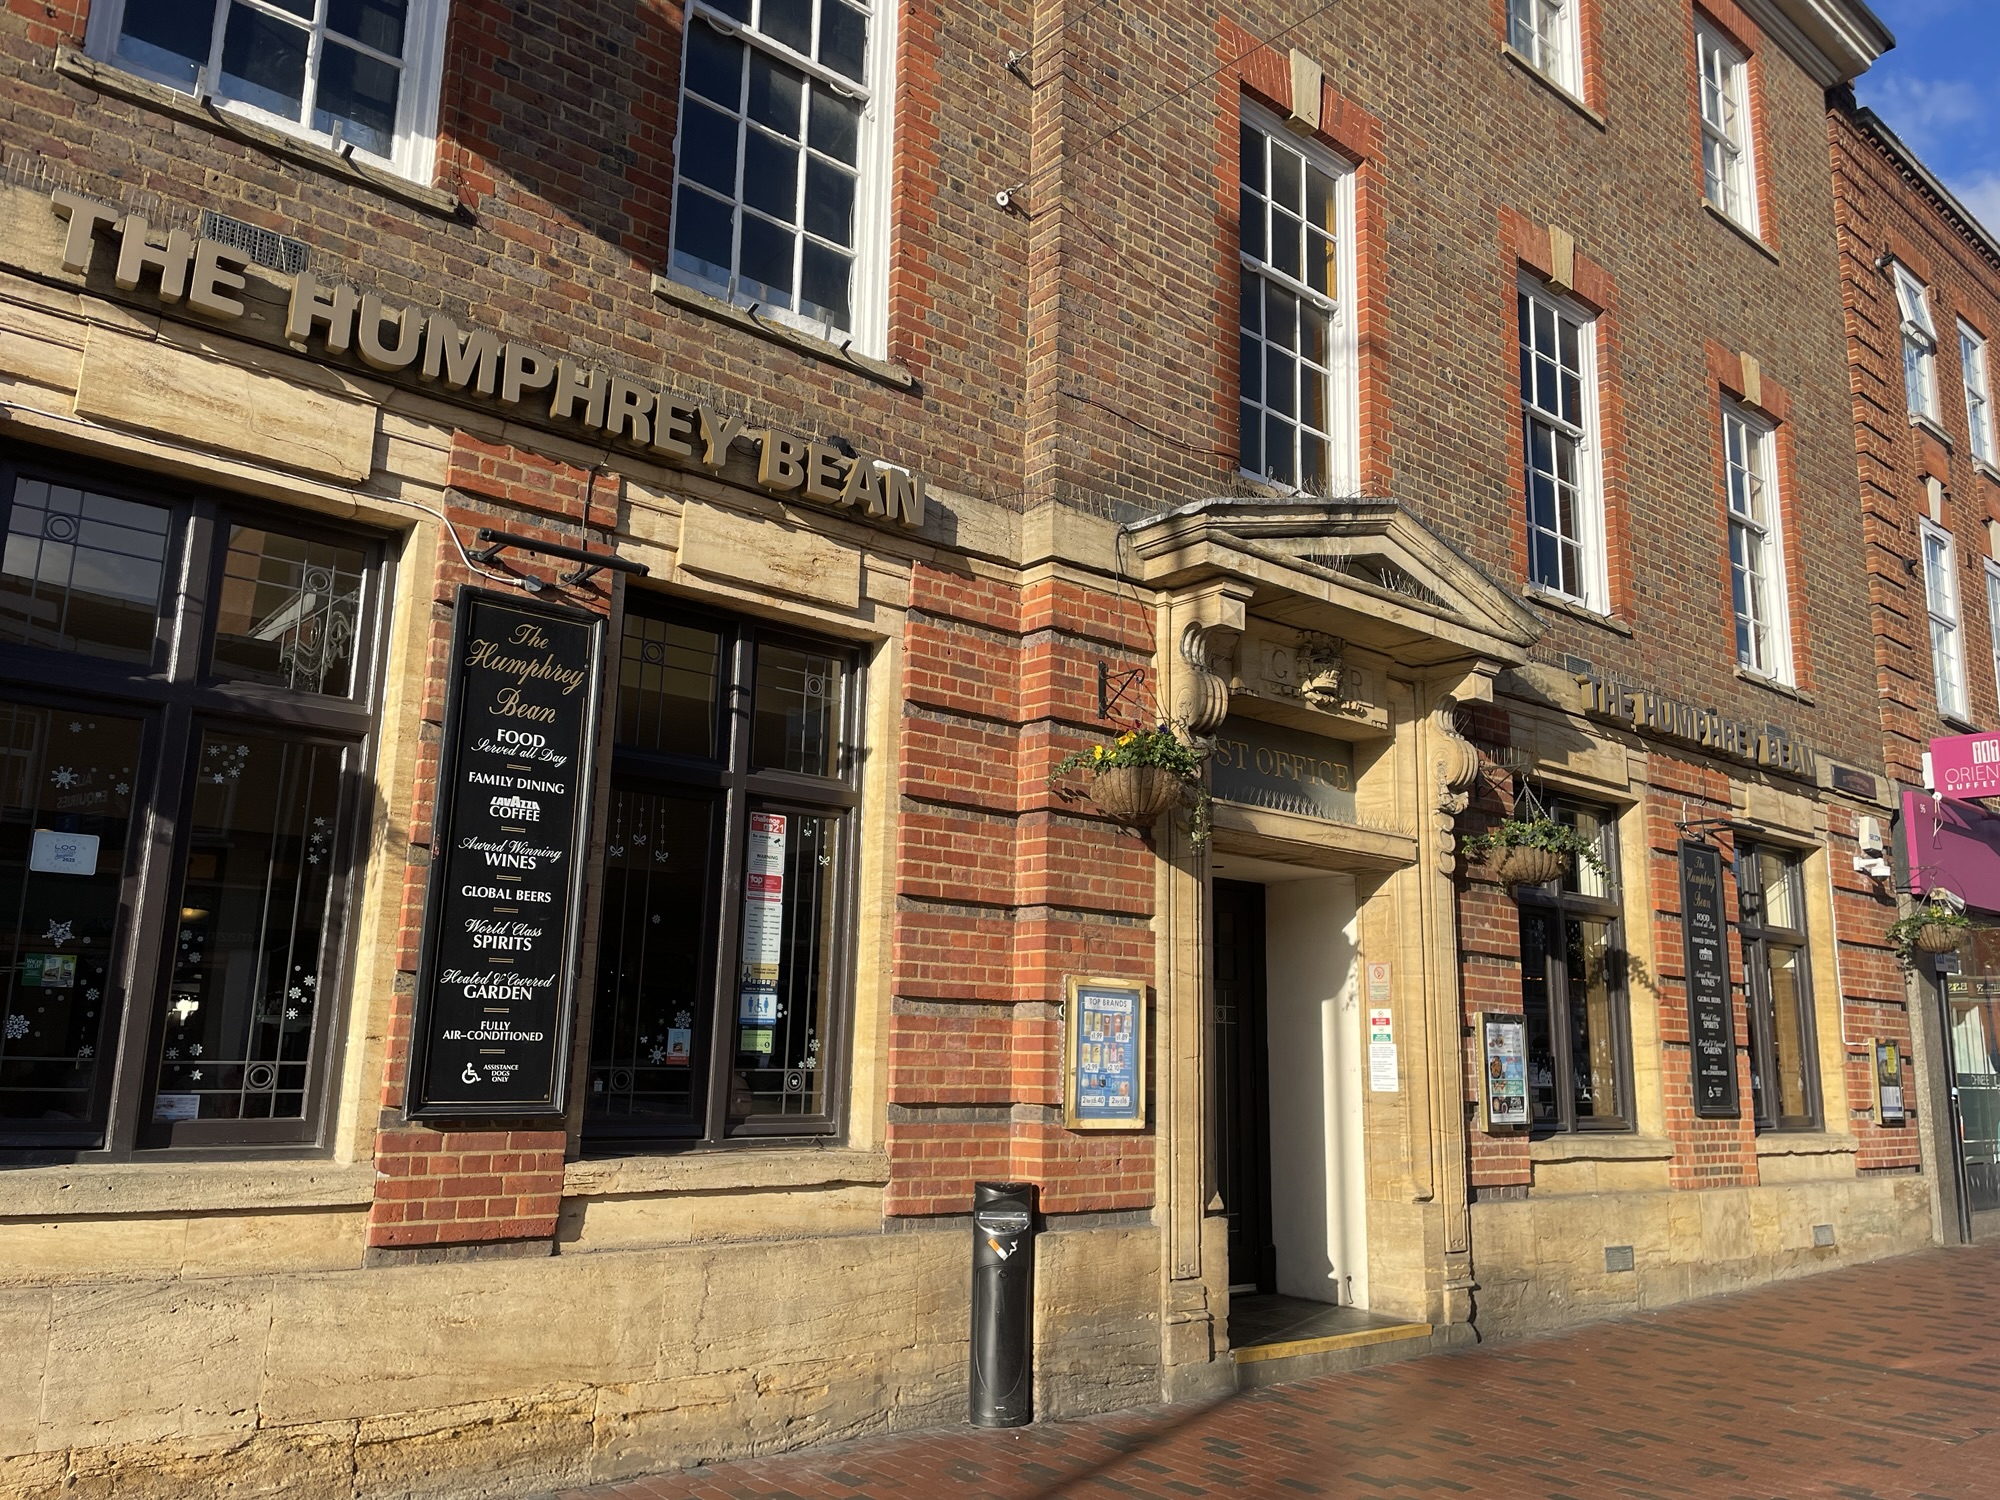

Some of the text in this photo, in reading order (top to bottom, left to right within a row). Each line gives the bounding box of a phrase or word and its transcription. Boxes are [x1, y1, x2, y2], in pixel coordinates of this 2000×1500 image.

[52, 189, 926, 529] THE HUMPHREY BEAN
[508, 623, 549, 648] The
[465, 639, 585, 695] Humphrey
[1272, 650, 1288, 679] G
[489, 687, 556, 723] Bean
[1576, 674, 1817, 777] THE HUMPHREY BEAN
[497, 728, 546, 748] FOOD
[471, 738, 567, 768] Served all Day
[1256, 747, 1350, 792] OFFICE
[468, 771, 565, 794] FAMILY DINING
[1947, 780, 1996, 791] BUFFET
[489, 806, 540, 822] COFFEE
[458, 836, 562, 863] Award Winning
[756, 853, 778, 861] WARNING
[485, 852, 537, 870] WINES
[461, 885, 551, 903] GLOBAL BEERS
[1696, 913, 1710, 921] FOOD
[464, 919, 542, 937] World Class
[473, 934, 532, 951] SPIRITS
[440, 969, 491, 985] Heated
[506, 972, 556, 988] Covered
[1700, 978, 1715, 987] WINES
[464, 984, 532, 1000] GARDEN
[1089, 998, 1100, 1006] TOP
[1103, 999, 1127, 1008] BRANDS
[480, 1020, 511, 1031] FULLY
[1703, 1020, 1719, 1029] SPIRITS
[442, 1030, 544, 1042] AIR-CONDITIONED
[1703, 1047, 1722, 1055] GARDEN
